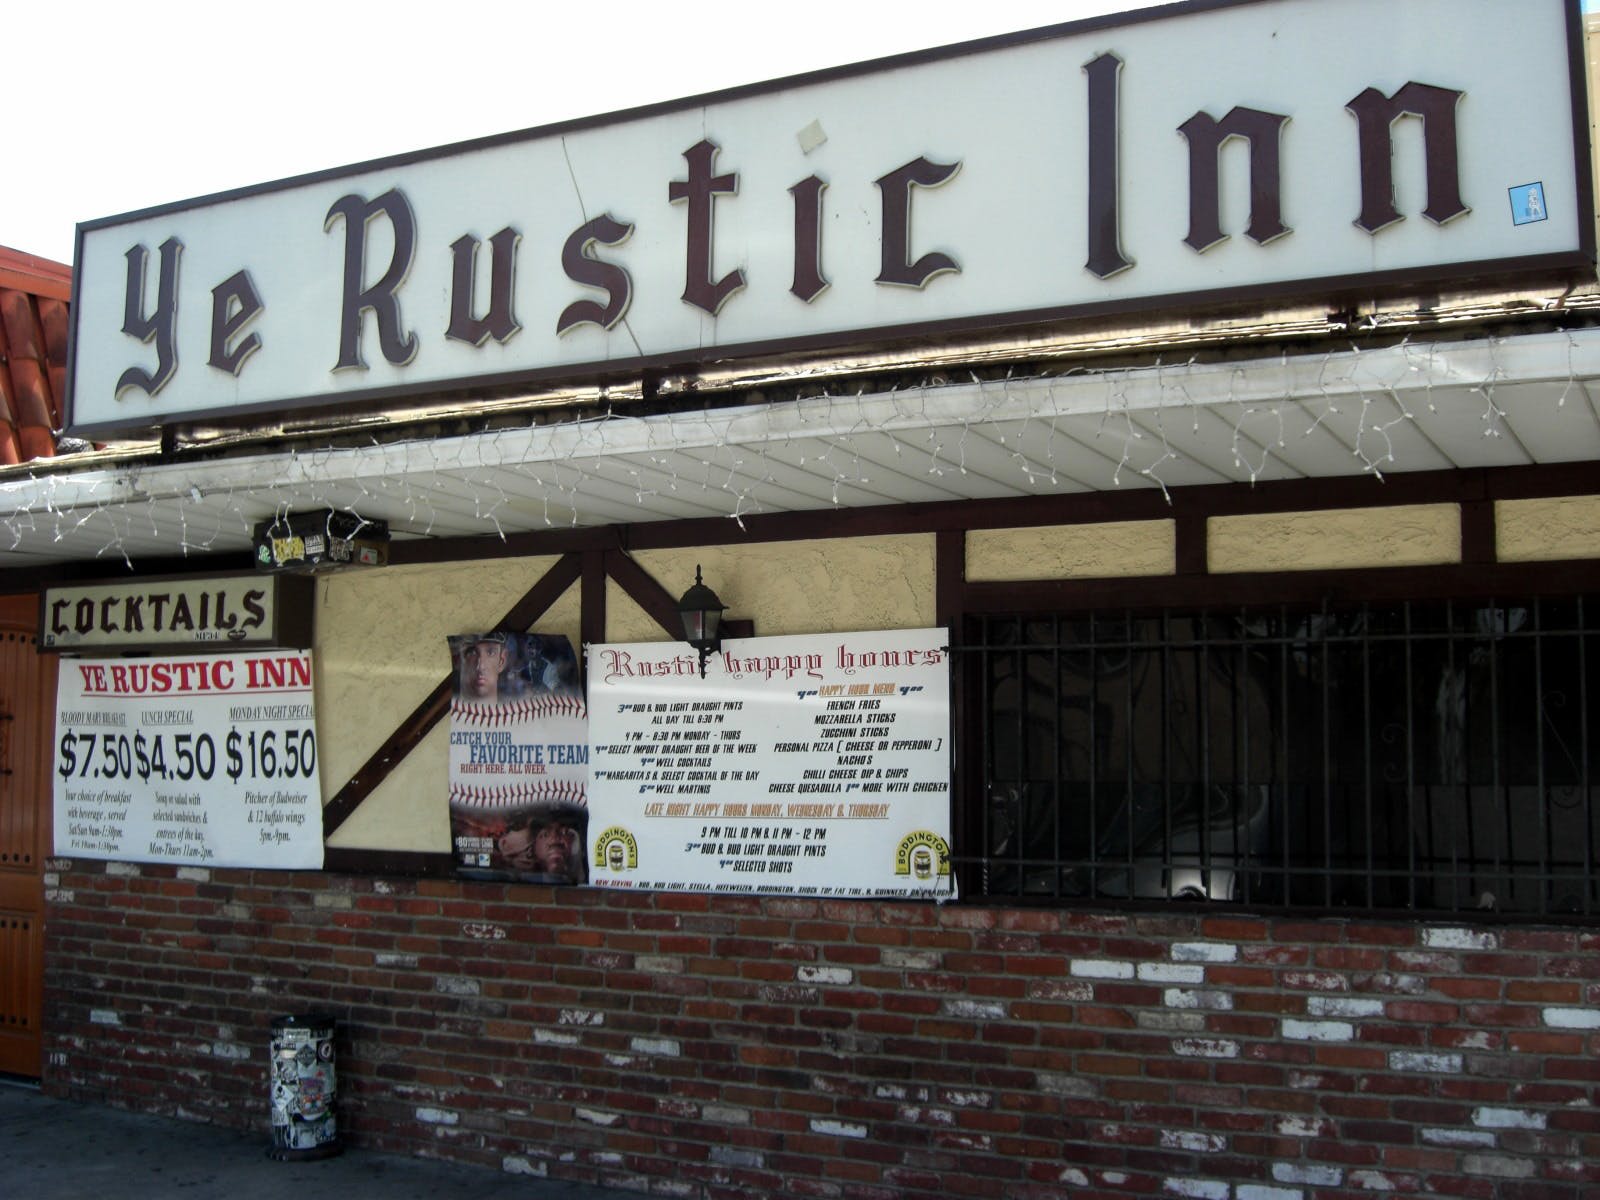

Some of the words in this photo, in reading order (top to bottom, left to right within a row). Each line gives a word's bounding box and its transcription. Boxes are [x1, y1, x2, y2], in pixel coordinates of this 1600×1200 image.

[323, 136, 963, 375] Rustic
[1082, 50, 1473, 281] Inn
[52, 590, 266, 635] COCKTAILS
[722, 650, 824, 681] happy
[836, 644, 944, 675] hours
[79, 664, 109, 693] YE
[110, 660, 235, 694] RUSTIC
[245, 657, 311, 689] INN
[819, 684, 845, 696] HAPPY
[229, 705, 262, 720] MONDAY
[262, 704, 288, 719] NIGHT
[632, 704, 646, 713] BUD
[654, 703, 668, 713] BUD
[669, 703, 690, 713] LIGHT
[691, 702, 722, 712] DRAUGHT
[722, 701, 744, 711] PINTS
[826, 700, 855, 711] FRENCH
[858, 699, 881, 710] FRIES
[141, 710, 162, 724] LUNCH
[163, 709, 194, 724] SPECIAL
[651, 716, 663, 725] ALL
[666, 715, 680, 725] DAY
[683, 715, 695, 724] TILL
[714, 714, 725, 723] PM
[814, 714, 863, 725] MOZZARELLA
[866, 713, 896, 724] STICKS
[450, 731, 482, 745] CATCH
[484, 731, 512, 745] YOUR
[632, 732, 643, 741] PM
[671, 731, 682, 741] PM
[683, 731, 712, 741] MONDAY
[720, 730, 742, 740] THURS
[820, 728, 857, 739] ZUCCHINI
[860, 727, 890, 738] STICKS
[607, 745, 631, 755] SELECT
[633, 745, 660, 754] IMPORT
[661, 744, 693, 754] DRAUGHT
[694, 744, 711, 754] BEER
[712, 744, 721, 754] OF
[722, 743, 735, 754] THE
[737, 743, 758, 754] WEEK
[774, 743, 810, 753] PERSONAL
[812, 742, 834, 753] PIZZA
[845, 740, 876, 752] CHEESE
[877, 740, 889, 751] OR
[891, 739, 933, 751] PEPPERONI
[59, 728, 132, 783] $7.50
[134, 729, 216, 785] $4.50
[225, 725, 316, 785] $16.50
[470, 744, 544, 765] FAVORITE
[547, 744, 590, 765] TEAM
[460, 764, 483, 775] RIGHT
[508, 764, 523, 775] ALL
[655, 758, 675, 768] WELL
[677, 757, 713, 768] COCKTAILS
[661, 771, 685, 781] SELECT
[687, 771, 718, 781] COCKTAIL
[720, 771, 729, 781] OF
[731, 771, 744, 781] THE
[745, 771, 760, 781] DAY
[803, 769, 826, 780] CHILLI
[828, 769, 859, 779] CHEESE
[860, 768, 875, 779] DIP
[885, 768, 909, 779] CHIPS
[655, 784, 675, 794] WELL
[677, 784, 712, 794] MARTINIS
[768, 783, 796, 793] CHEESE
[797, 783, 842, 795] QUESADILLA
[861, 783, 883, 793] MORE
[886, 782, 910, 793] WITH
[912, 782, 949, 793] CHICKEN
[77, 789, 97, 802] choice
[97, 789, 105, 806] of
[104, 789, 132, 806] breakfast
[245, 791, 269, 805] Pitcher
[268, 791, 277, 808] of
[644, 803, 665, 817] LATE
[693, 803, 721, 817] HAPPY
[285, 810, 305, 827] wings
[701, 826, 708, 838] 9
[709, 827, 722, 839] PM
[724, 827, 737, 839] TILL
[740, 827, 749, 839] 10
[751, 827, 762, 839] PM
[781, 828, 793, 839] PM
[803, 828, 812, 840] 12
[814, 828, 827, 840] PM
[597, 828, 635, 858] BODDINGTONS
[700, 843, 717, 855] BUD
[726, 844, 742, 855] BUD
[743, 844, 765, 856] LIGHT
[767, 844, 802, 857] DRAUGHT
[804, 845, 827, 857] PINTS
[733, 860, 767, 873] SELECTED
[768, 862, 793, 873] SHOTS
